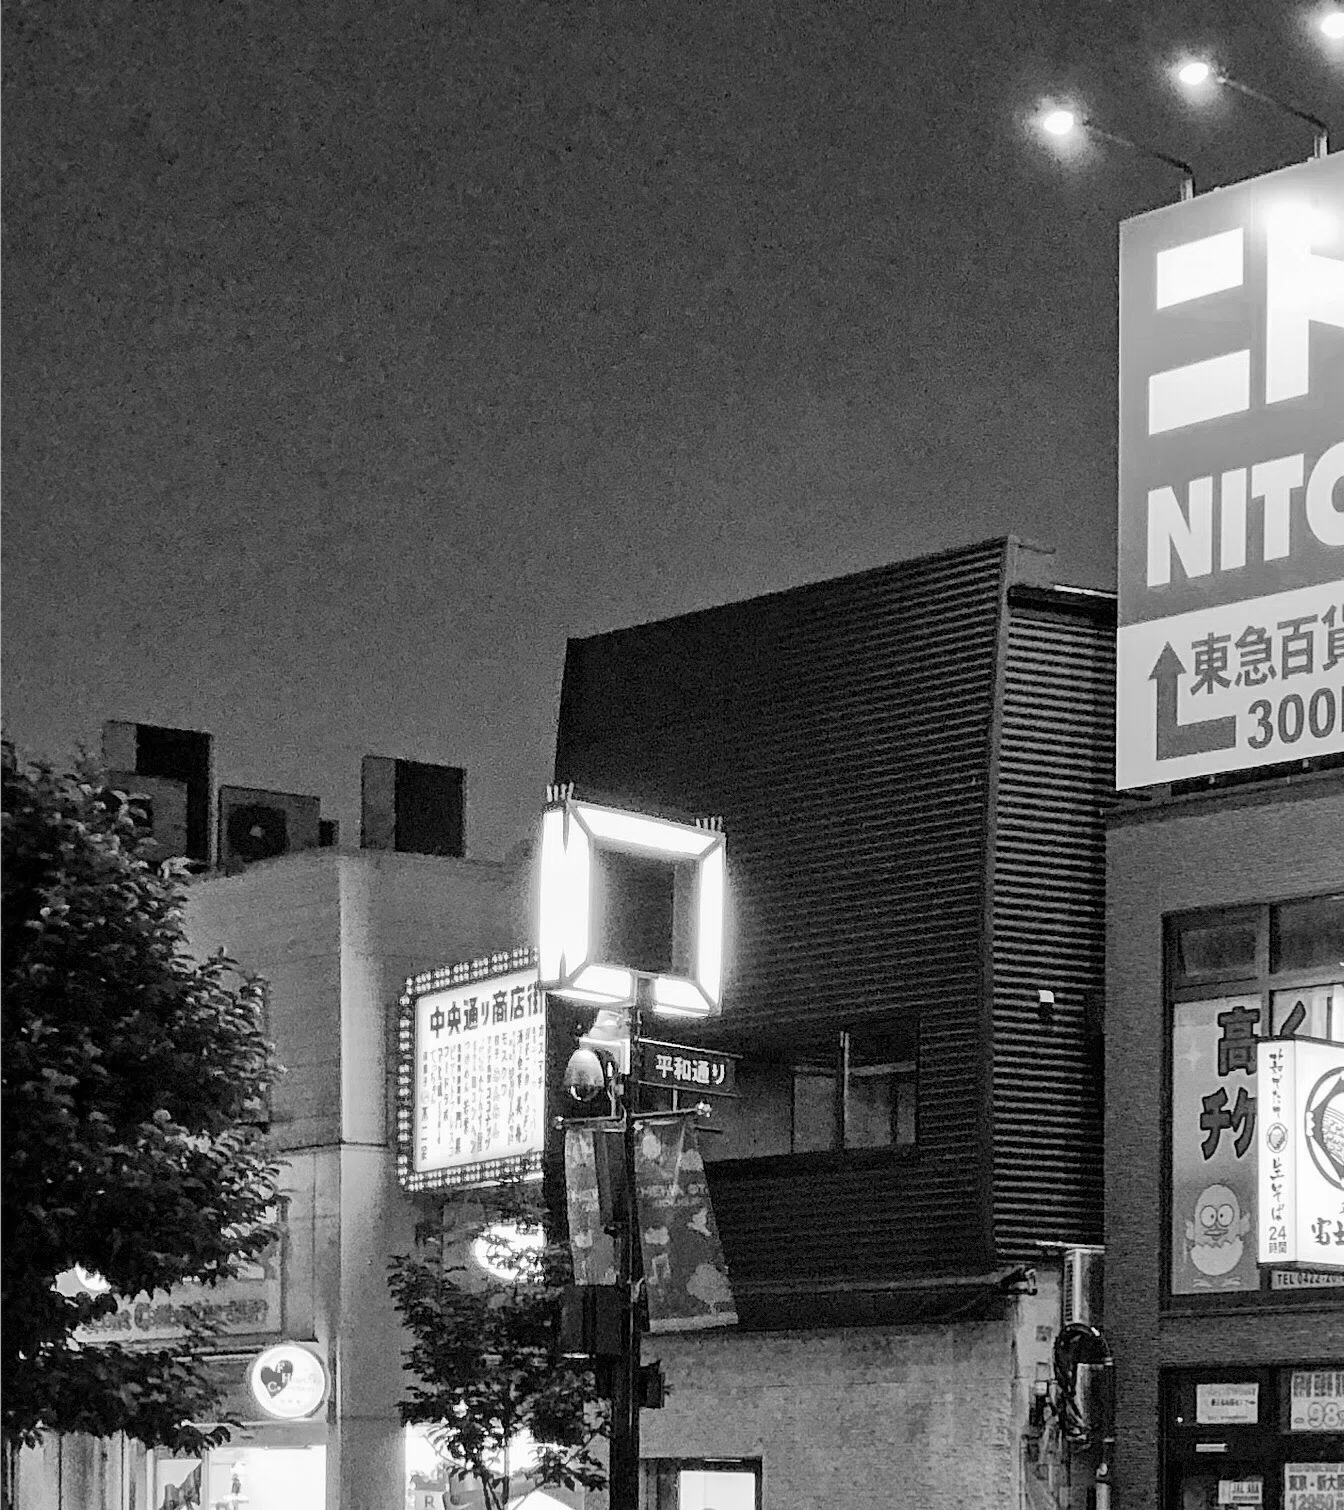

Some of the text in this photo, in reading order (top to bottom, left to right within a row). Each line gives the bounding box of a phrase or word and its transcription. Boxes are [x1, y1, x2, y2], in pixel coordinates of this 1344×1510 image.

[656, 1054, 726, 1085] 平和通り
[1268, 1225, 1287, 1241] 24
